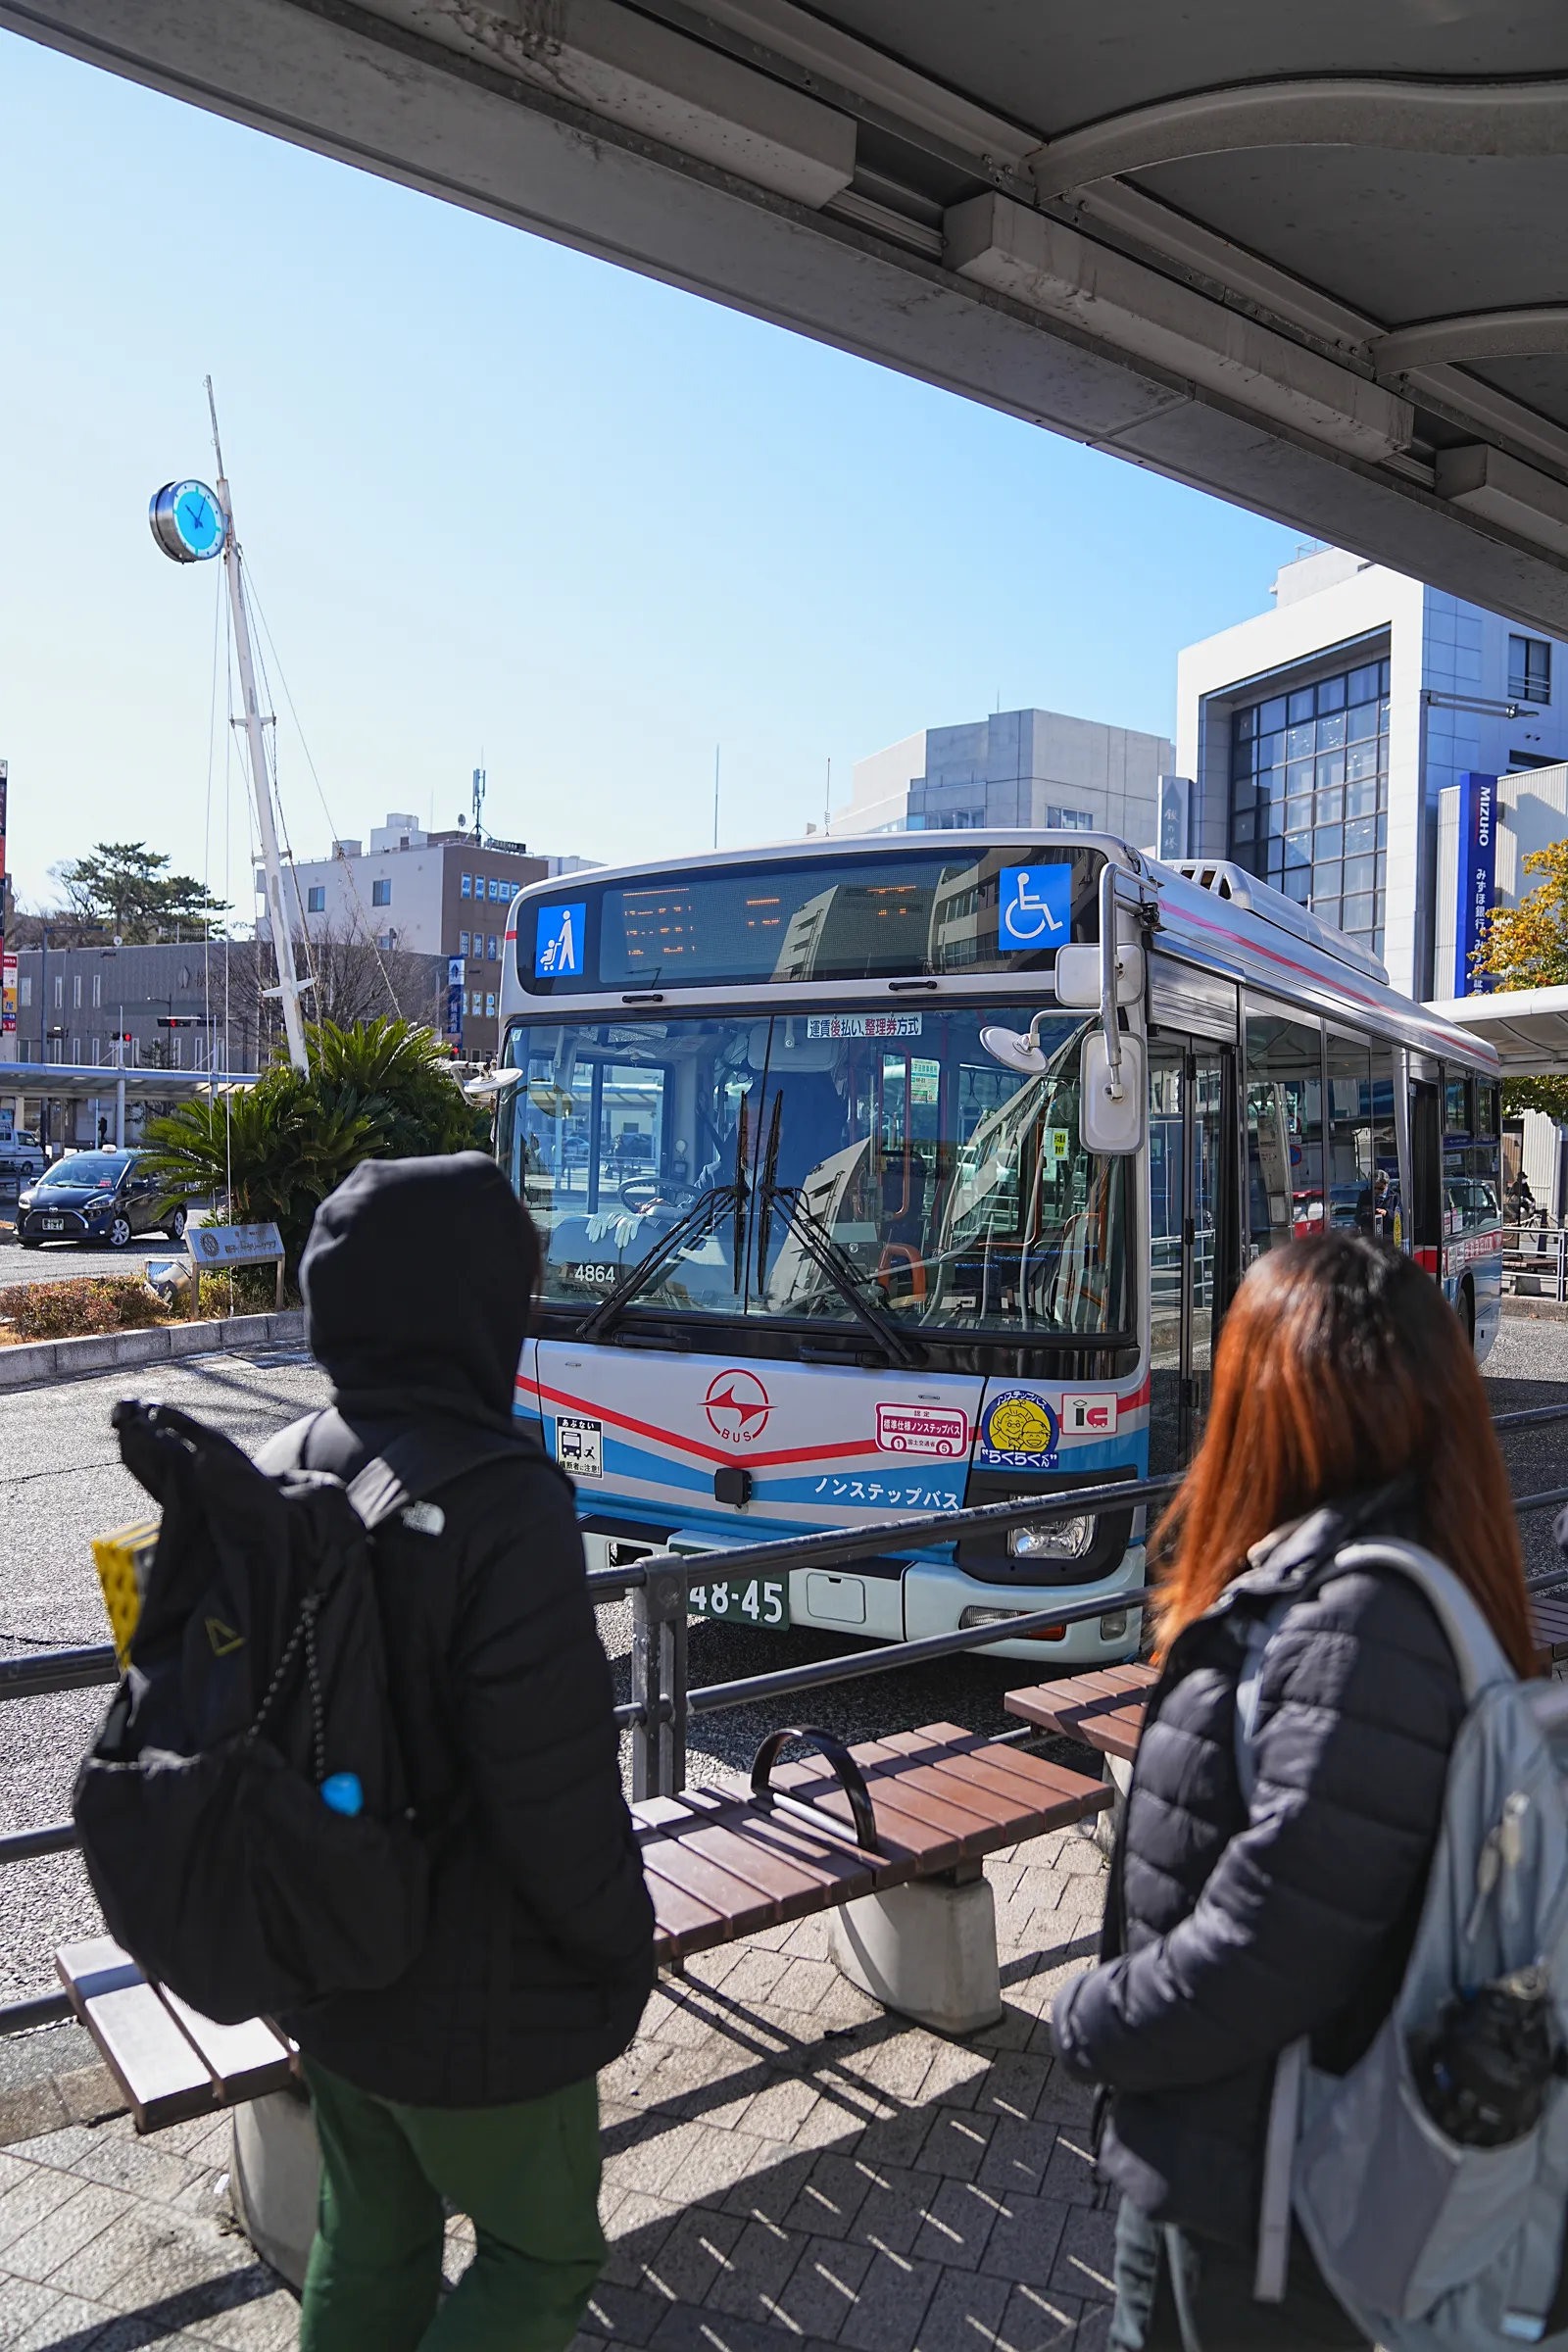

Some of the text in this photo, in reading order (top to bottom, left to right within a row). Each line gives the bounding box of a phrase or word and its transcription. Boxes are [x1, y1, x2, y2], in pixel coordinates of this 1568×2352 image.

[1479, 787, 1492, 847] MIZUHO
[1475, 868, 1487, 930] みずほ銀行
[809, 1017, 919, 1037] 運賃後払い、整理券方式
[574, 1264, 616, 1284] 4864
[997, 1391, 1048, 1410] ノンステップバス
[562, 1418, 595, 1430] あぶない
[883, 1418, 960, 1436] 標準仕様ノンステップバス
[721, 1428, 753, 1444] BUS
[907, 1439, 936, 1447] 国土交通省
[814, 1477, 959, 1510] ノンステップバス
[689, 1579, 783, 1624] 48-45
